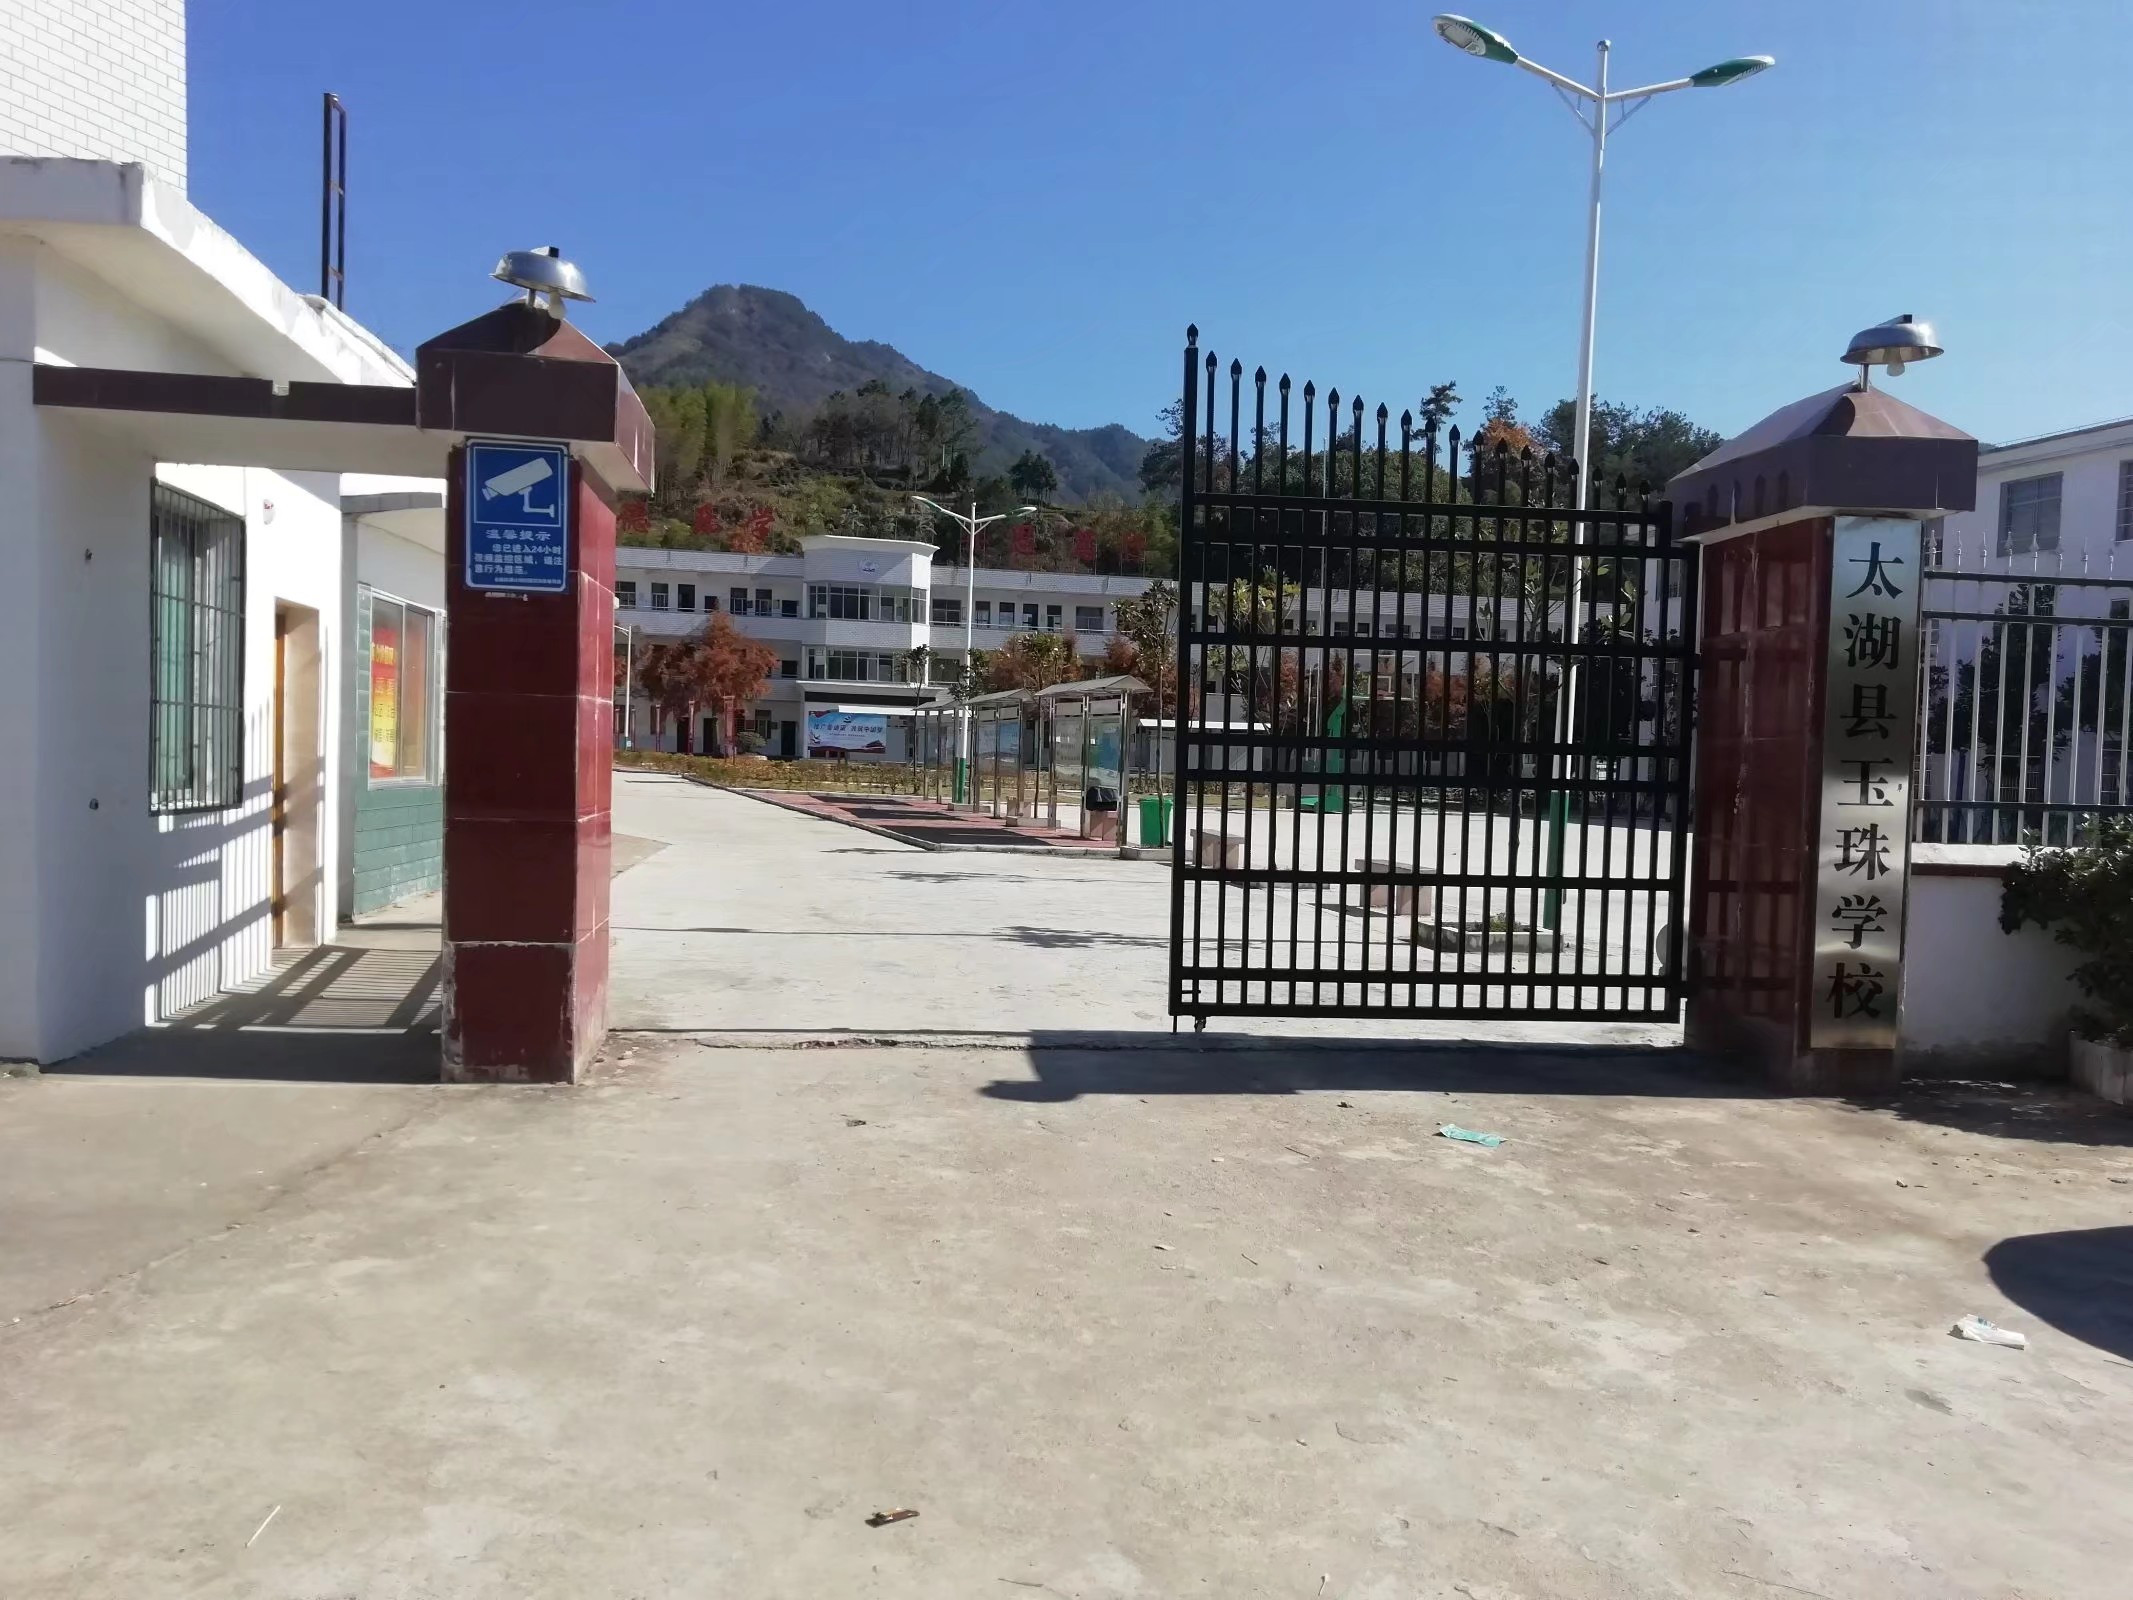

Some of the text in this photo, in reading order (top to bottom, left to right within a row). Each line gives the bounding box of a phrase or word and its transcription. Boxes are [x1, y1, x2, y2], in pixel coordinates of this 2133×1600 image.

[485, 529, 551, 541] 温馨提示
[1826, 541, 1904, 1020] 太湖县玉珠学校
